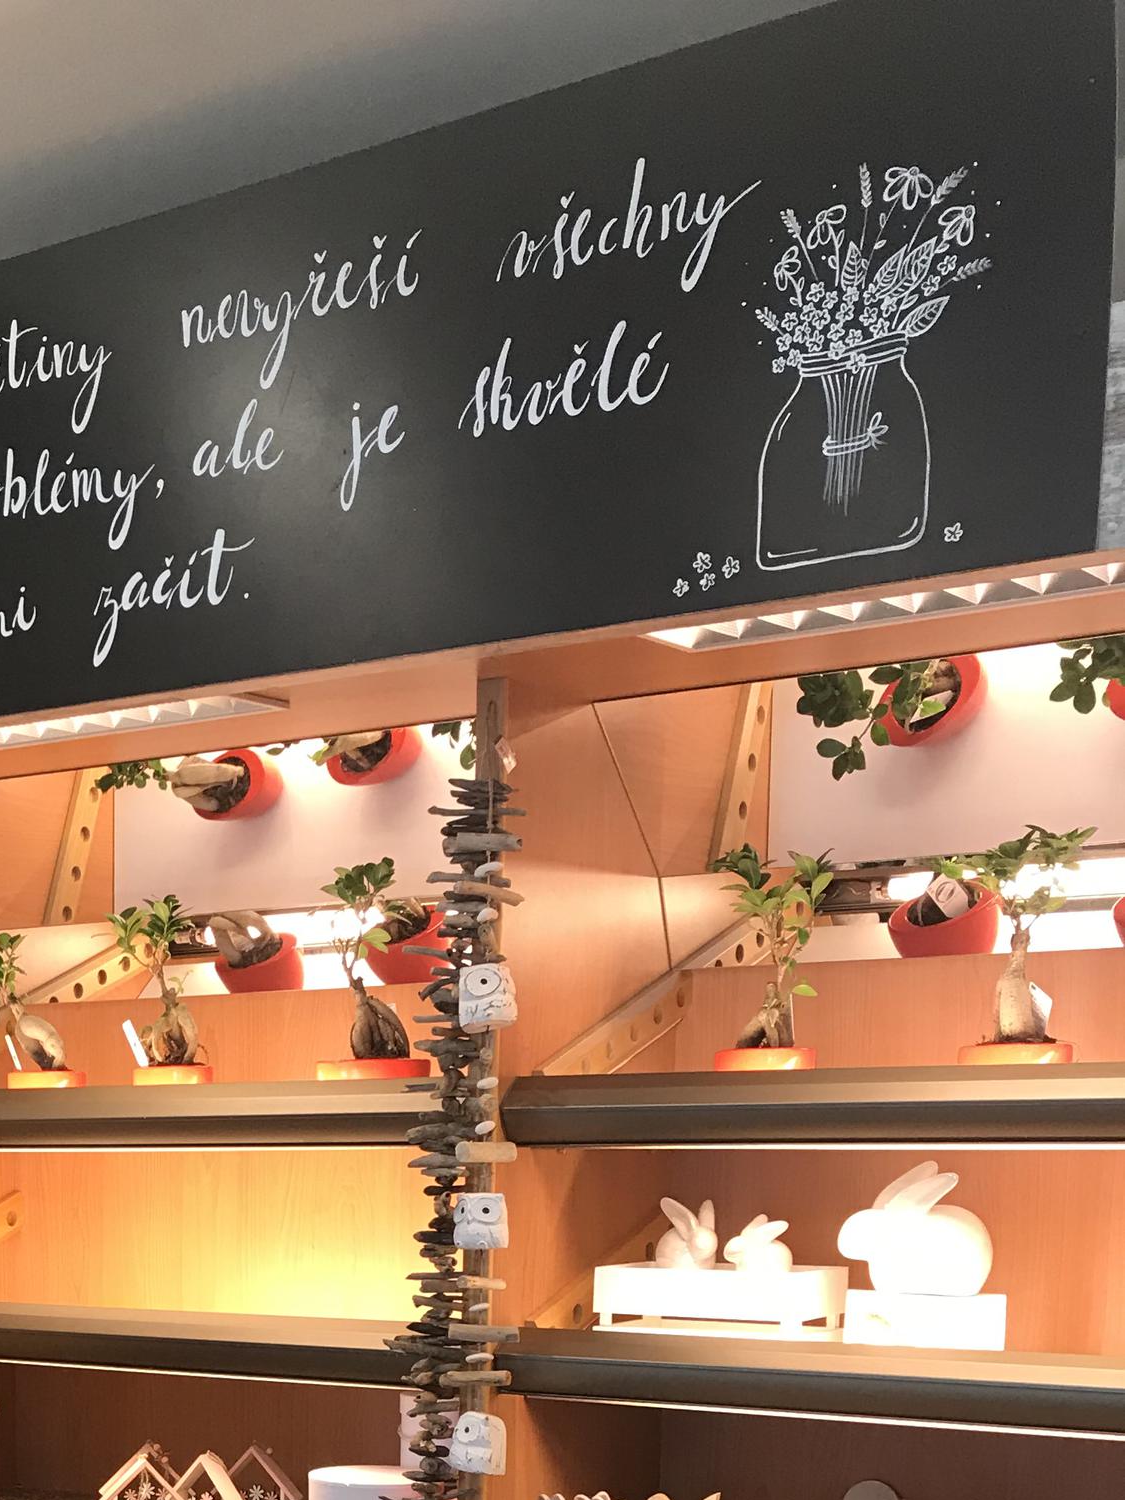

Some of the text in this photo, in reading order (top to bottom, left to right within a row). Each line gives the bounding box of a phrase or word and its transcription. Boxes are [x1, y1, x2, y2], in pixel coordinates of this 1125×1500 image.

[181, 229, 423, 389] nevyřeší
[495, 157, 762, 292] všechny
[192, 399, 284, 477] ale
[339, 402, 405, 511] je
[458, 319, 670, 437] skvělé
[92, 528, 255, 667] začít.
